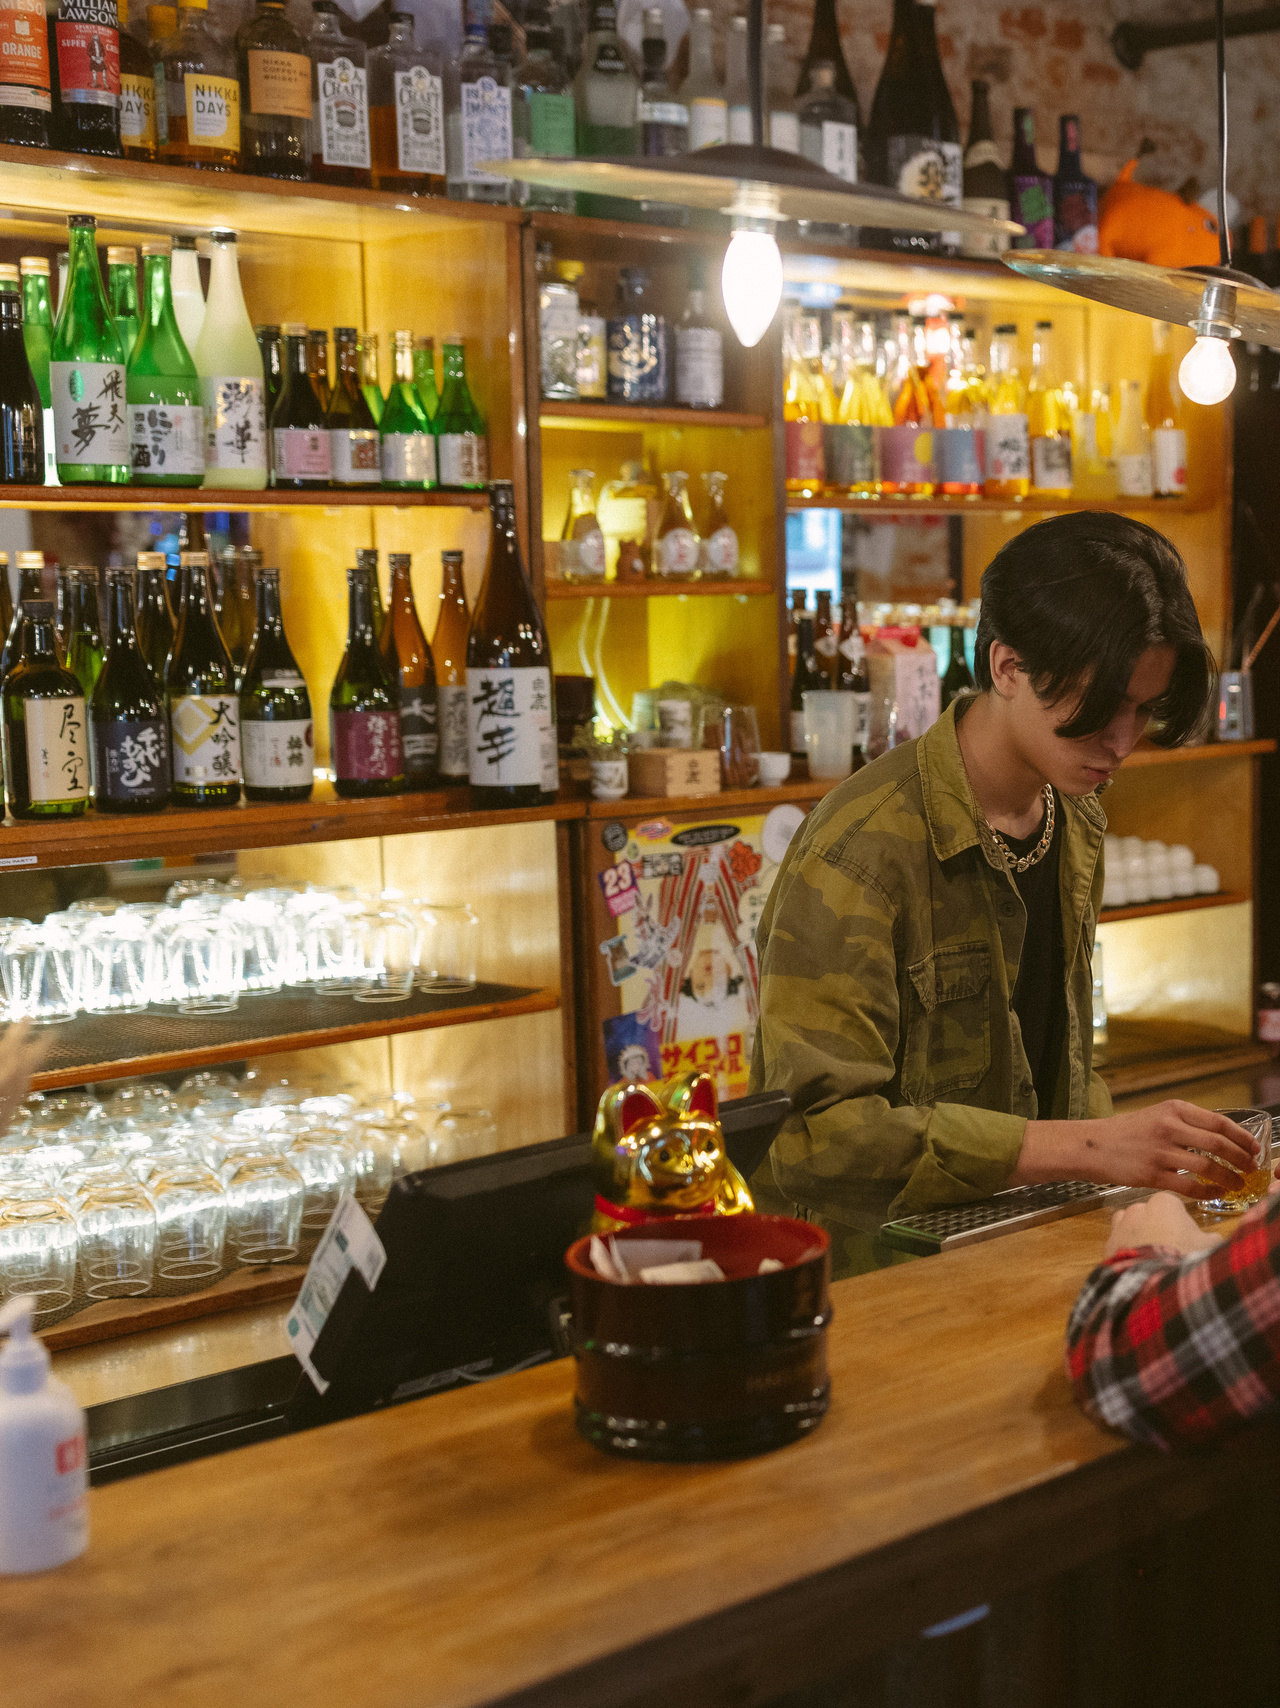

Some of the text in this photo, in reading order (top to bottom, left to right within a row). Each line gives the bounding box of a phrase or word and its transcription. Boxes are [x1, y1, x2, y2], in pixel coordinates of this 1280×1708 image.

[62, 0, 118, 14] WILLIAM
[2, 42, 42, 60] ORANGE
[61, 40, 87, 48] SUPER
[194, 83, 238, 102] NIKKA
[195, 101, 231, 117] DAYS
[209, 700, 237, 777] 大吟醸
[603, 861, 632, 896] 23
[662, 1034, 742, 1068] サイコロ
